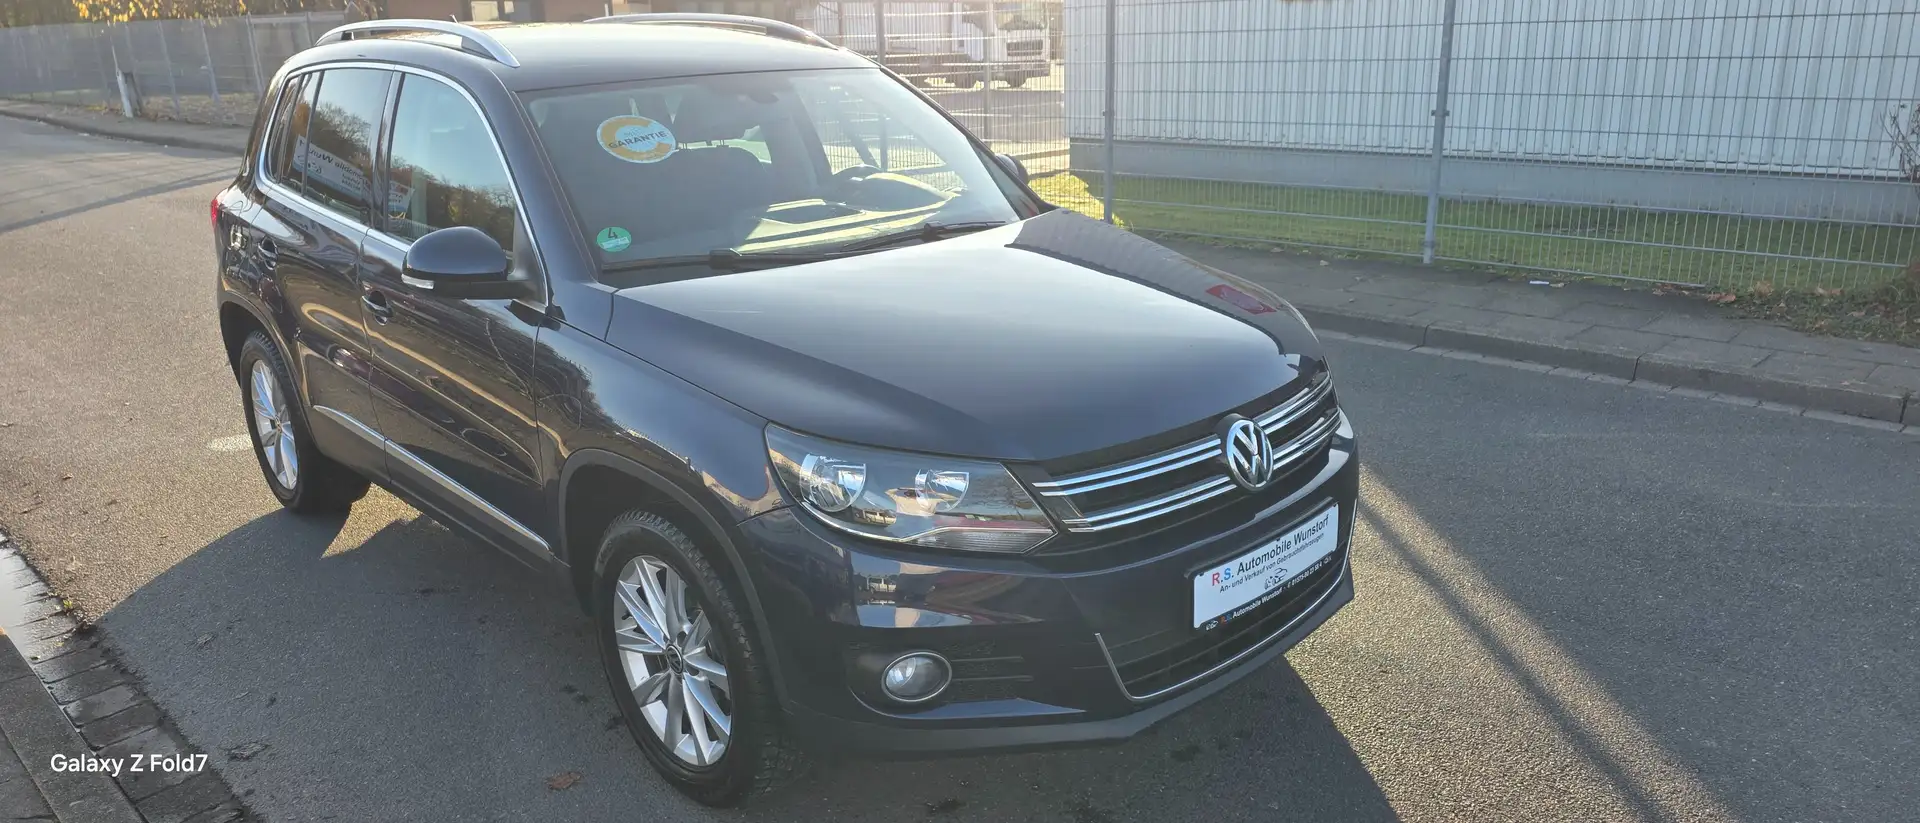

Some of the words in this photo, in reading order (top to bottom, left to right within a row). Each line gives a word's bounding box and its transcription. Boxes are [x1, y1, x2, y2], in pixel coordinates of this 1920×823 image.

[608, 130, 668, 149] GARANTIE
[607, 227, 618, 239] 4
[1211, 567, 1235, 587] R.S.
[1237, 540, 1292, 576] Automobile
[1293, 513, 1330, 546] Wunstorf
[1219, 584, 1232, 594] An-
[1231, 576, 1244, 588] und
[1244, 565, 1266, 580] Verkauf
[1265, 560, 1277, 571] von
[1232, 600, 1261, 619] Automobile
